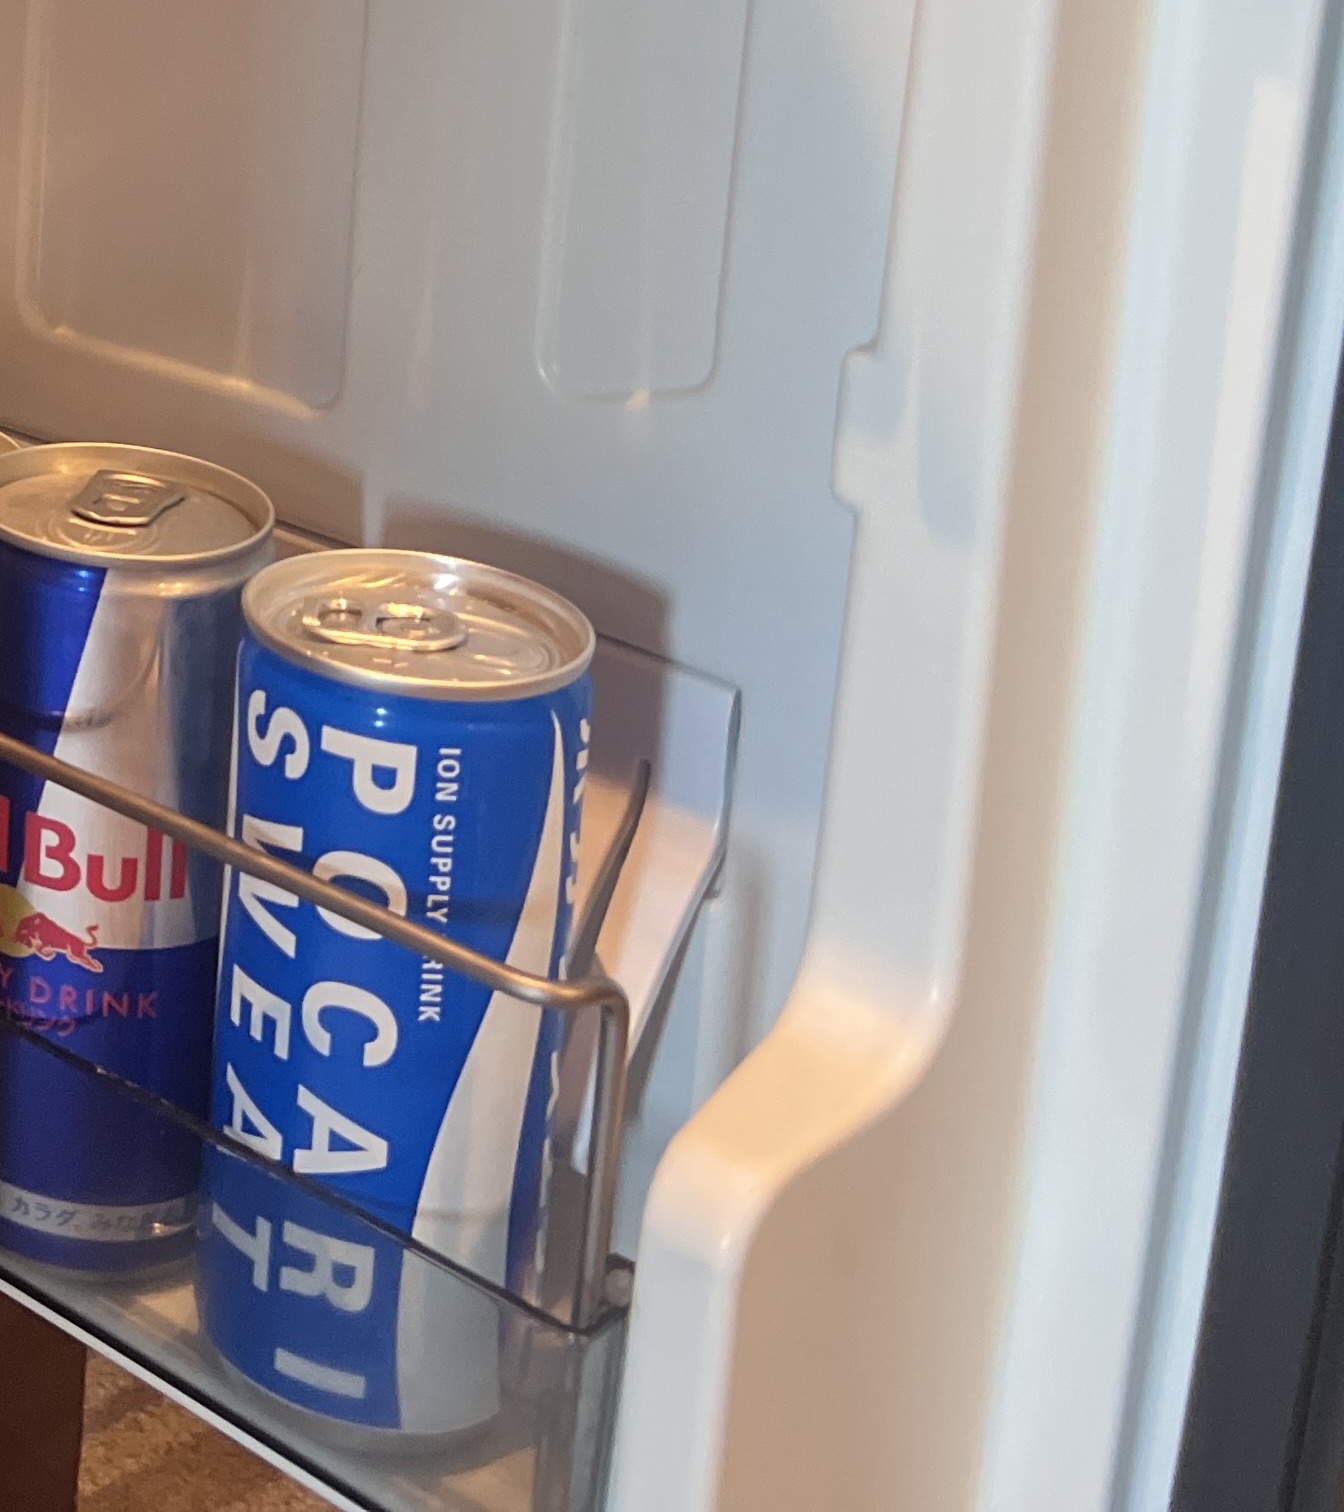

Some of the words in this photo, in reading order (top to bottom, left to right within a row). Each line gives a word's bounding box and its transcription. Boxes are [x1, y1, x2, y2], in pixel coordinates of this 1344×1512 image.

[434, 747, 463, 803] ION
[23, 810, 188, 904] Bull
[425, 813, 457, 925] SUPPLY
[29, 975, 160, 1019] DRINK
[211, 689, 310, 1293] SWEAT
[417, 948, 446, 1023] RINK
[273, 724, 418, 1400] POCARI
